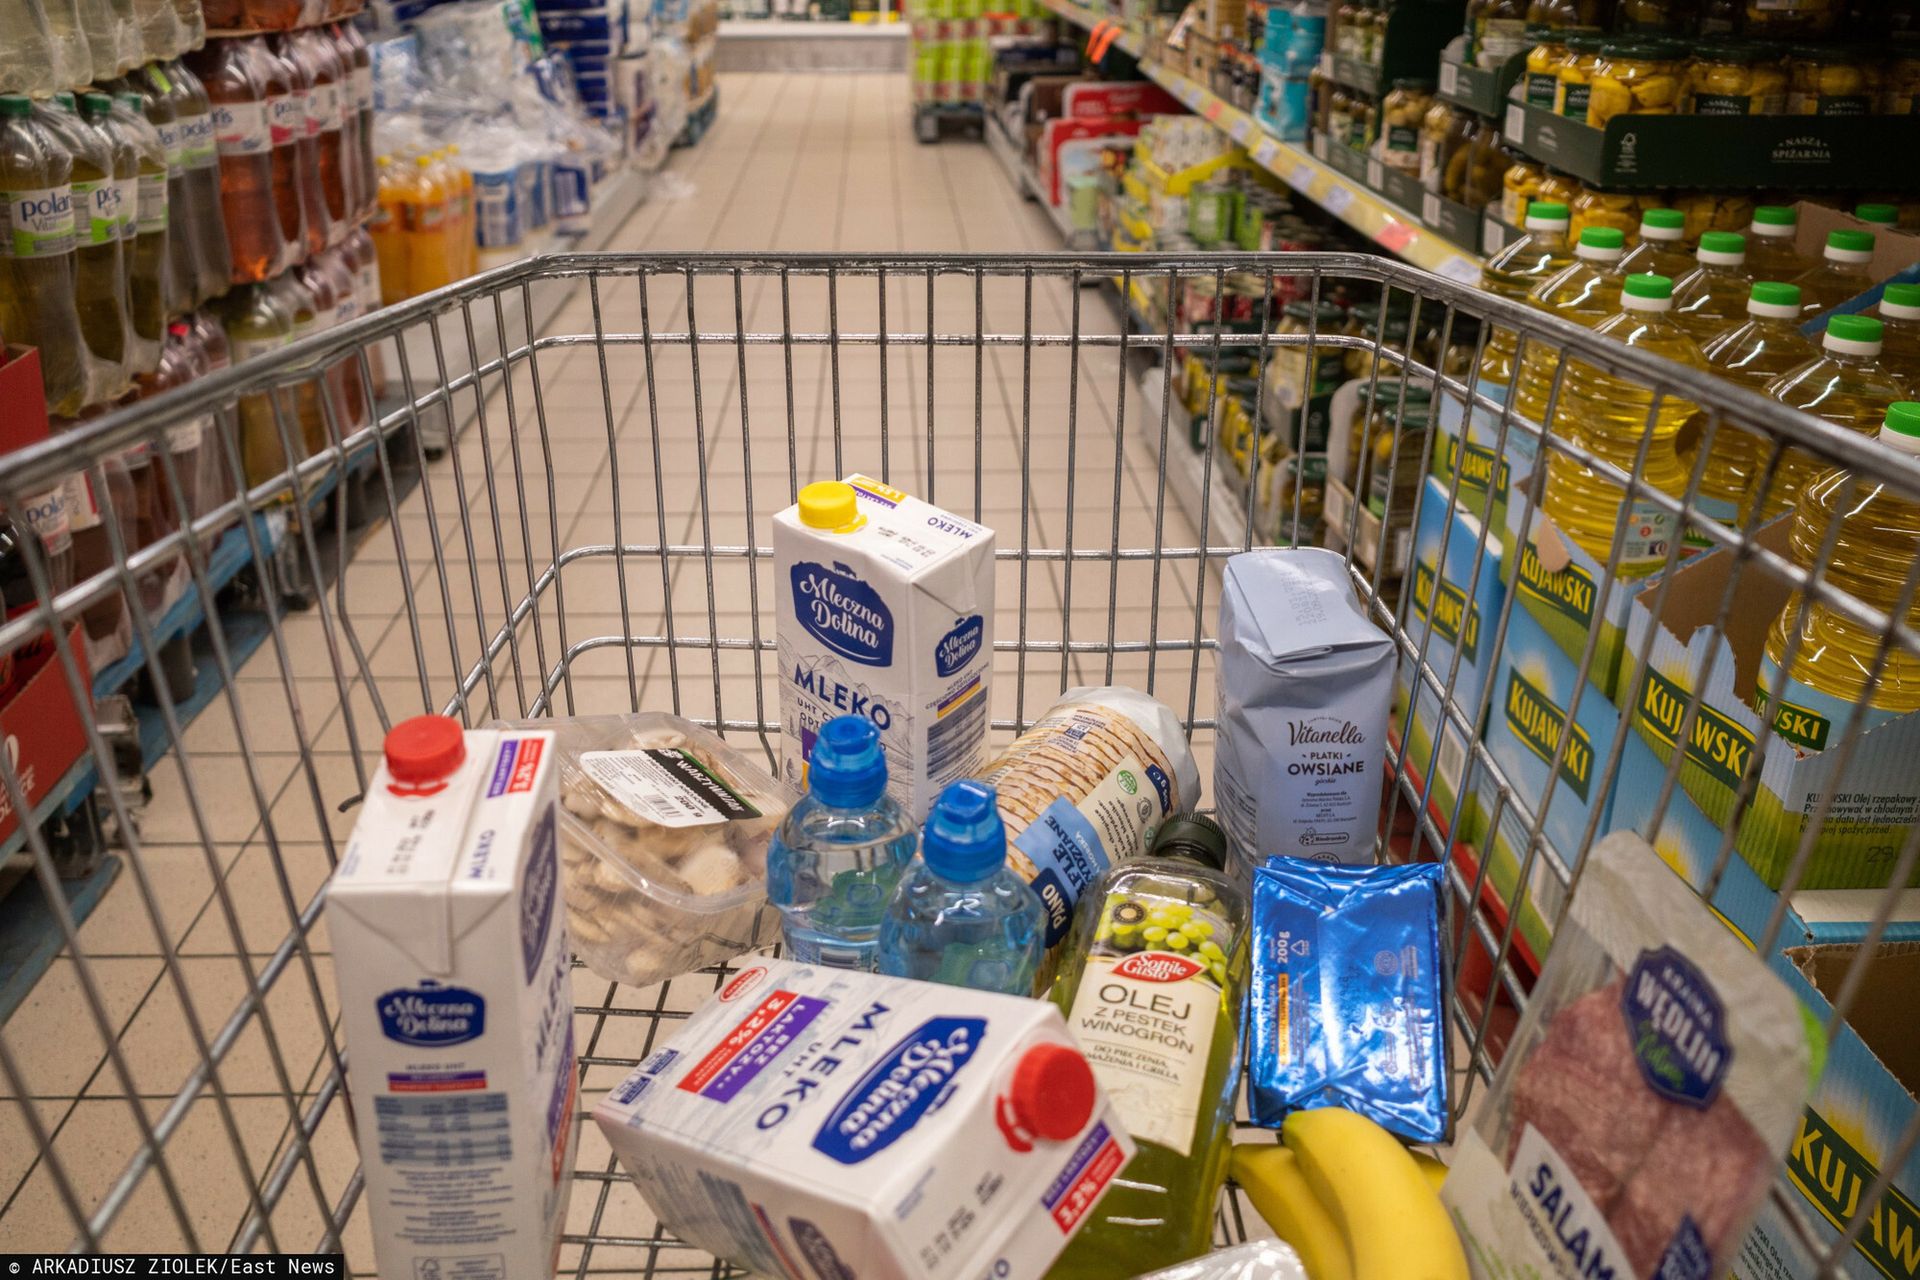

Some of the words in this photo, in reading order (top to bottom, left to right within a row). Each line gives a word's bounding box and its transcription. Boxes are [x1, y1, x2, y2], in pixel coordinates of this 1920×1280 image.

[1785, 135, 1822, 148] NASZA
[927, 515, 973, 540] MLEKO
[800, 573, 885, 631] Mleczna
[811, 602, 879, 649] Dolina
[939, 624, 980, 659] Mleczna
[945, 638, 977, 669] Dolina
[793, 662, 892, 731] MLEKO
[796, 697, 818, 715] UHT
[1286, 720, 1367, 748] Vitanella
[1286, 760, 1365, 777] OWSIANE
[1309, 751, 1344, 761] PŁATKI
[1853, 793, 1872, 805] Olej
[1042, 883, 1068, 930] PANO
[384, 996, 477, 1018] Mleczna
[1099, 983, 1192, 1021] OLEJ
[396, 1014, 470, 1036] Dolina
[728, 995, 786, 1048] 3,2%
[1081, 1017, 1195, 1055] WINOGRON
[1093, 1006, 1110, 1018] Z
[1112, 1007, 1188, 1038] PESTEK
[1636, 970, 1721, 1084] WĘDLIN
[752, 1032, 793, 1067] BEZ
[756, 1001, 891, 1131] MLEKO
[783, 1041, 823, 1077] UHT
[839, 1038, 943, 1137] Dolina
[848, 1025, 970, 1152] Mleczna
[1057, 1178, 1099, 1227] 3,2%
